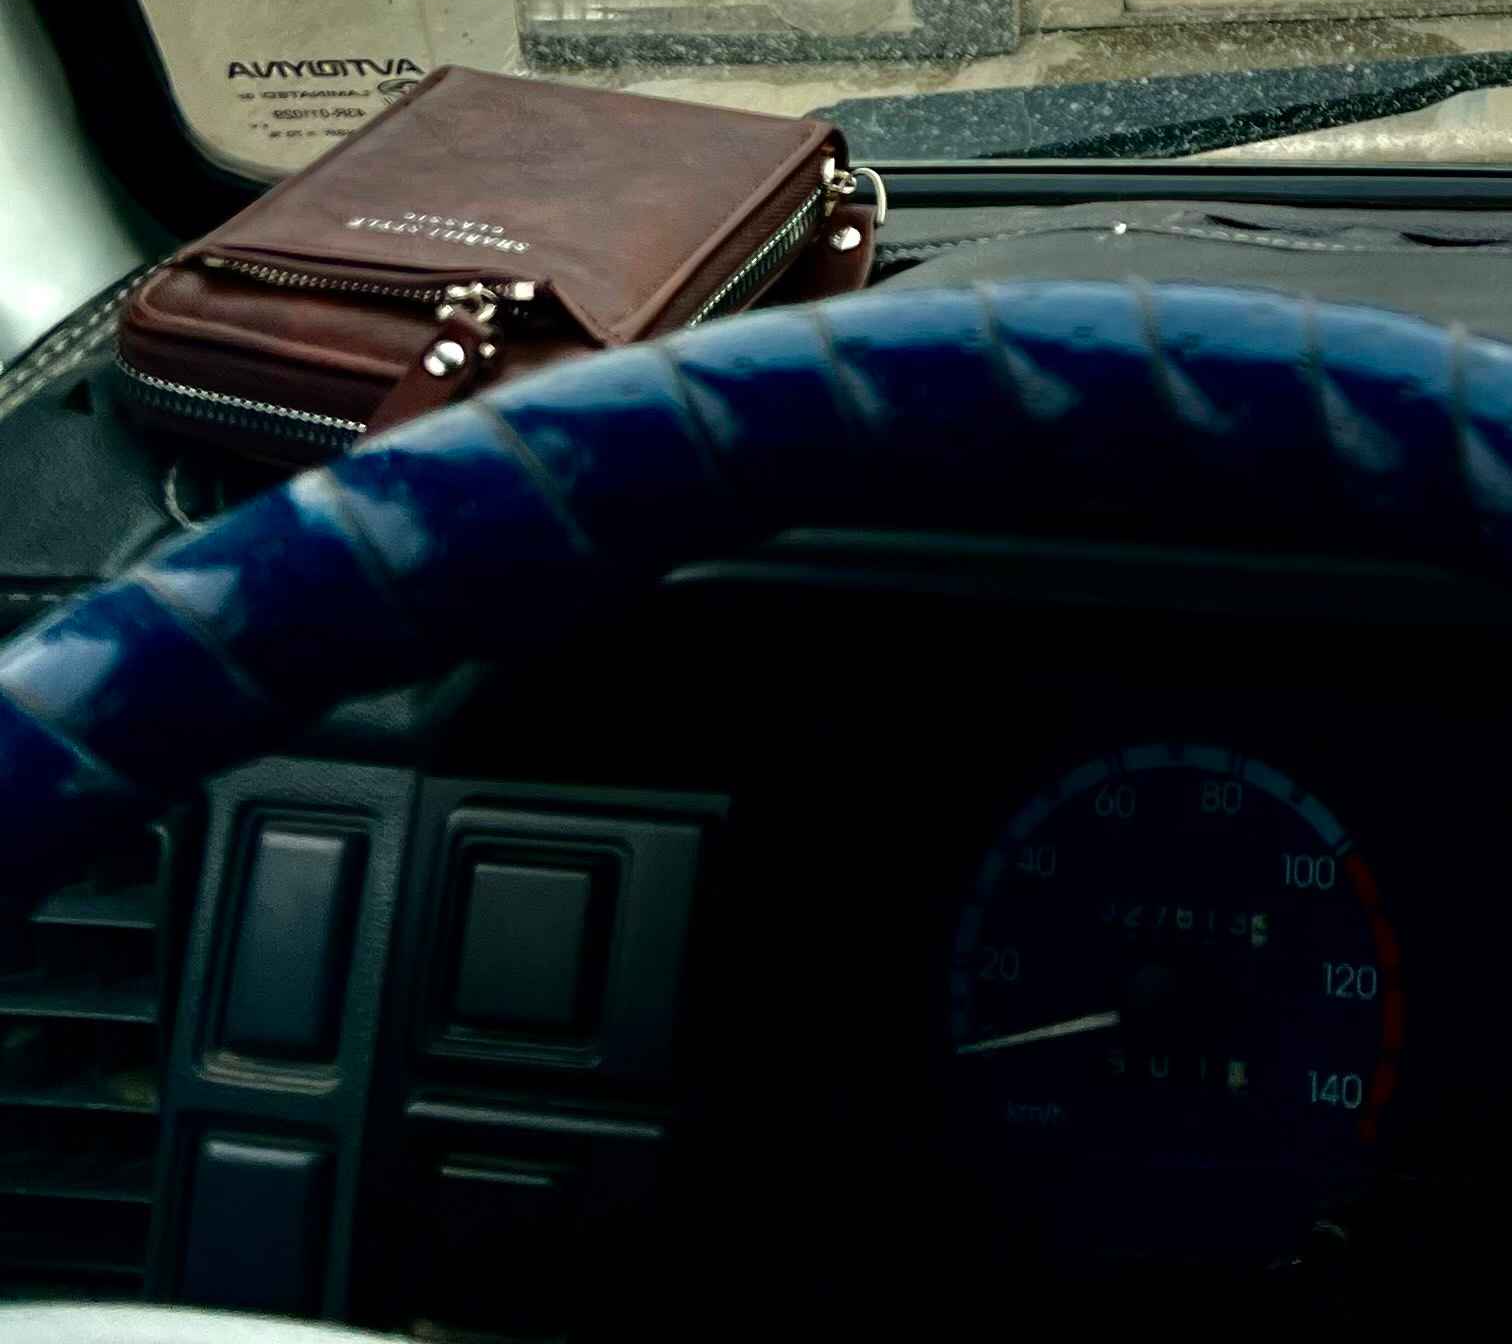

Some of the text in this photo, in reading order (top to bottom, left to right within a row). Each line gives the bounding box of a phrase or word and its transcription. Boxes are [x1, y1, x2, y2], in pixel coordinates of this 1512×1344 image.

[1283, 852, 1336, 890] 100
[1323, 960, 1378, 1000] 120
[1308, 1069, 1363, 1109] 140
